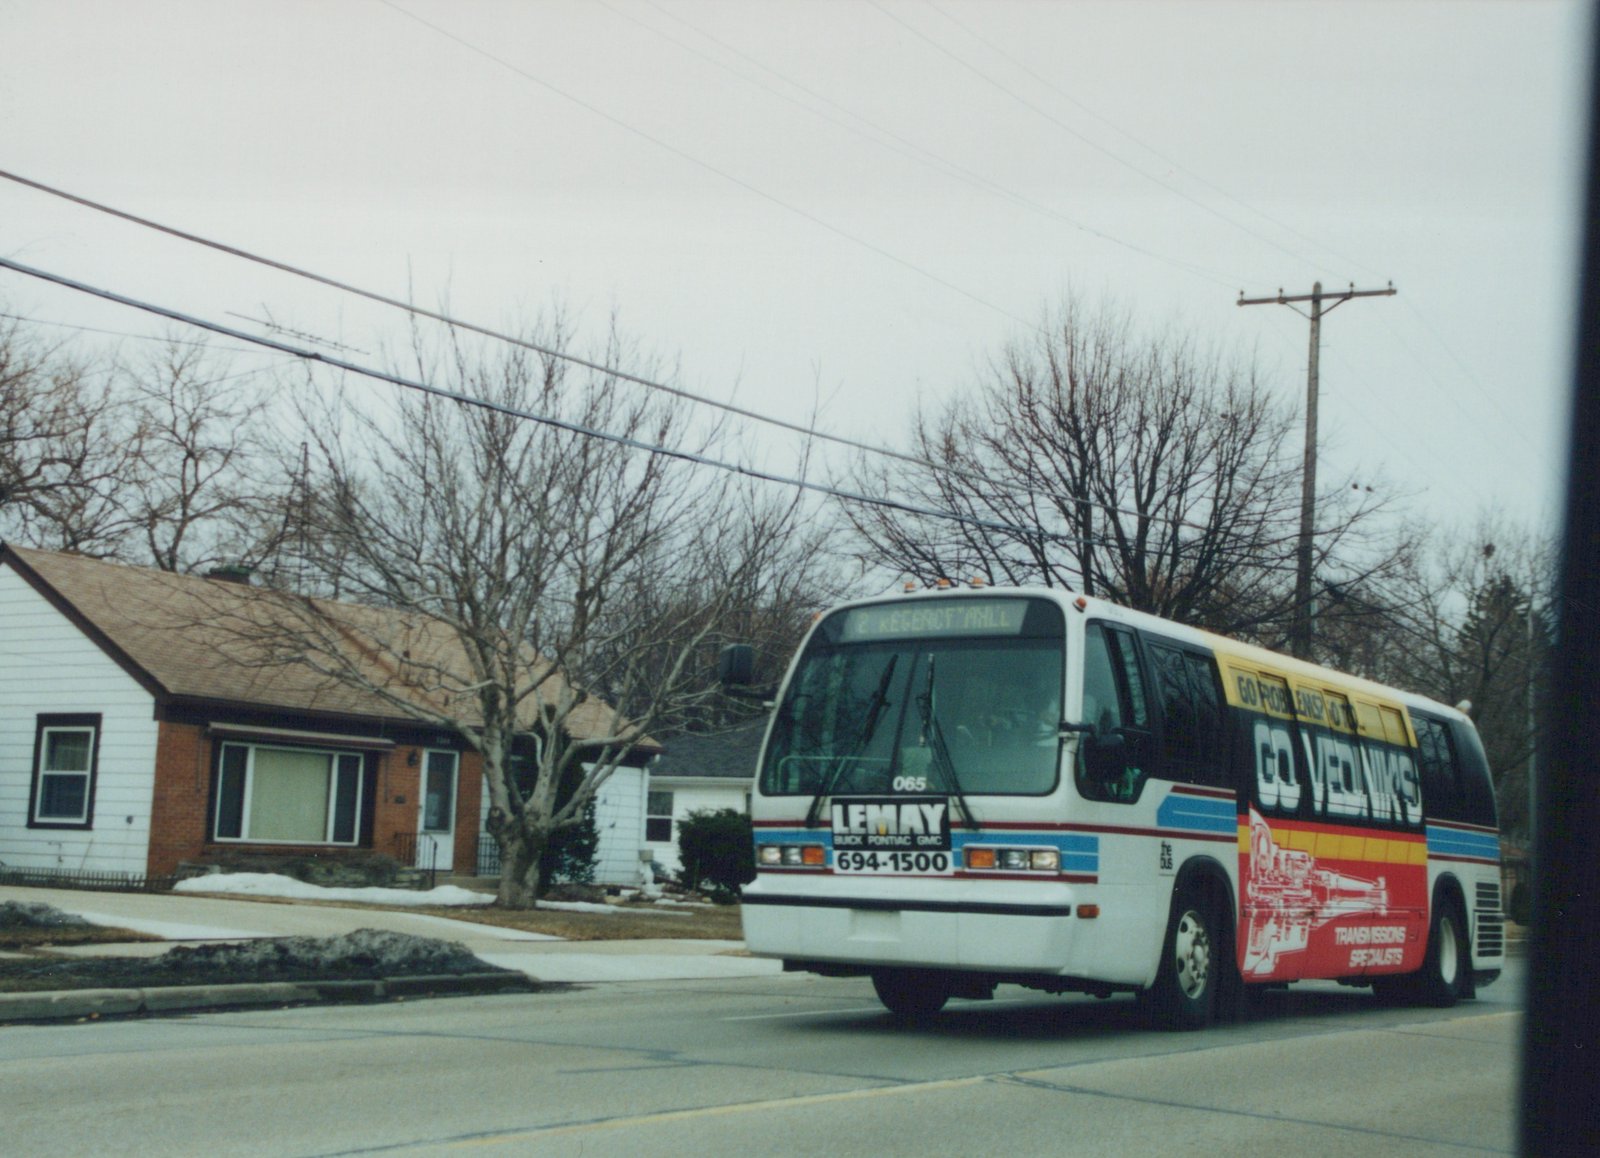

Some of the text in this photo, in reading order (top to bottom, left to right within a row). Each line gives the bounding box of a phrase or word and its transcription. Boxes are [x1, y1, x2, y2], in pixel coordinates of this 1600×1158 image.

[1254, 722, 1300, 809] GO
[892, 775, 927, 791] 065
[831, 803, 946, 835] LEMAY
[834, 835, 943, 846] BUICK PONTIAC GMC
[837, 852, 948, 872] 694-1500
